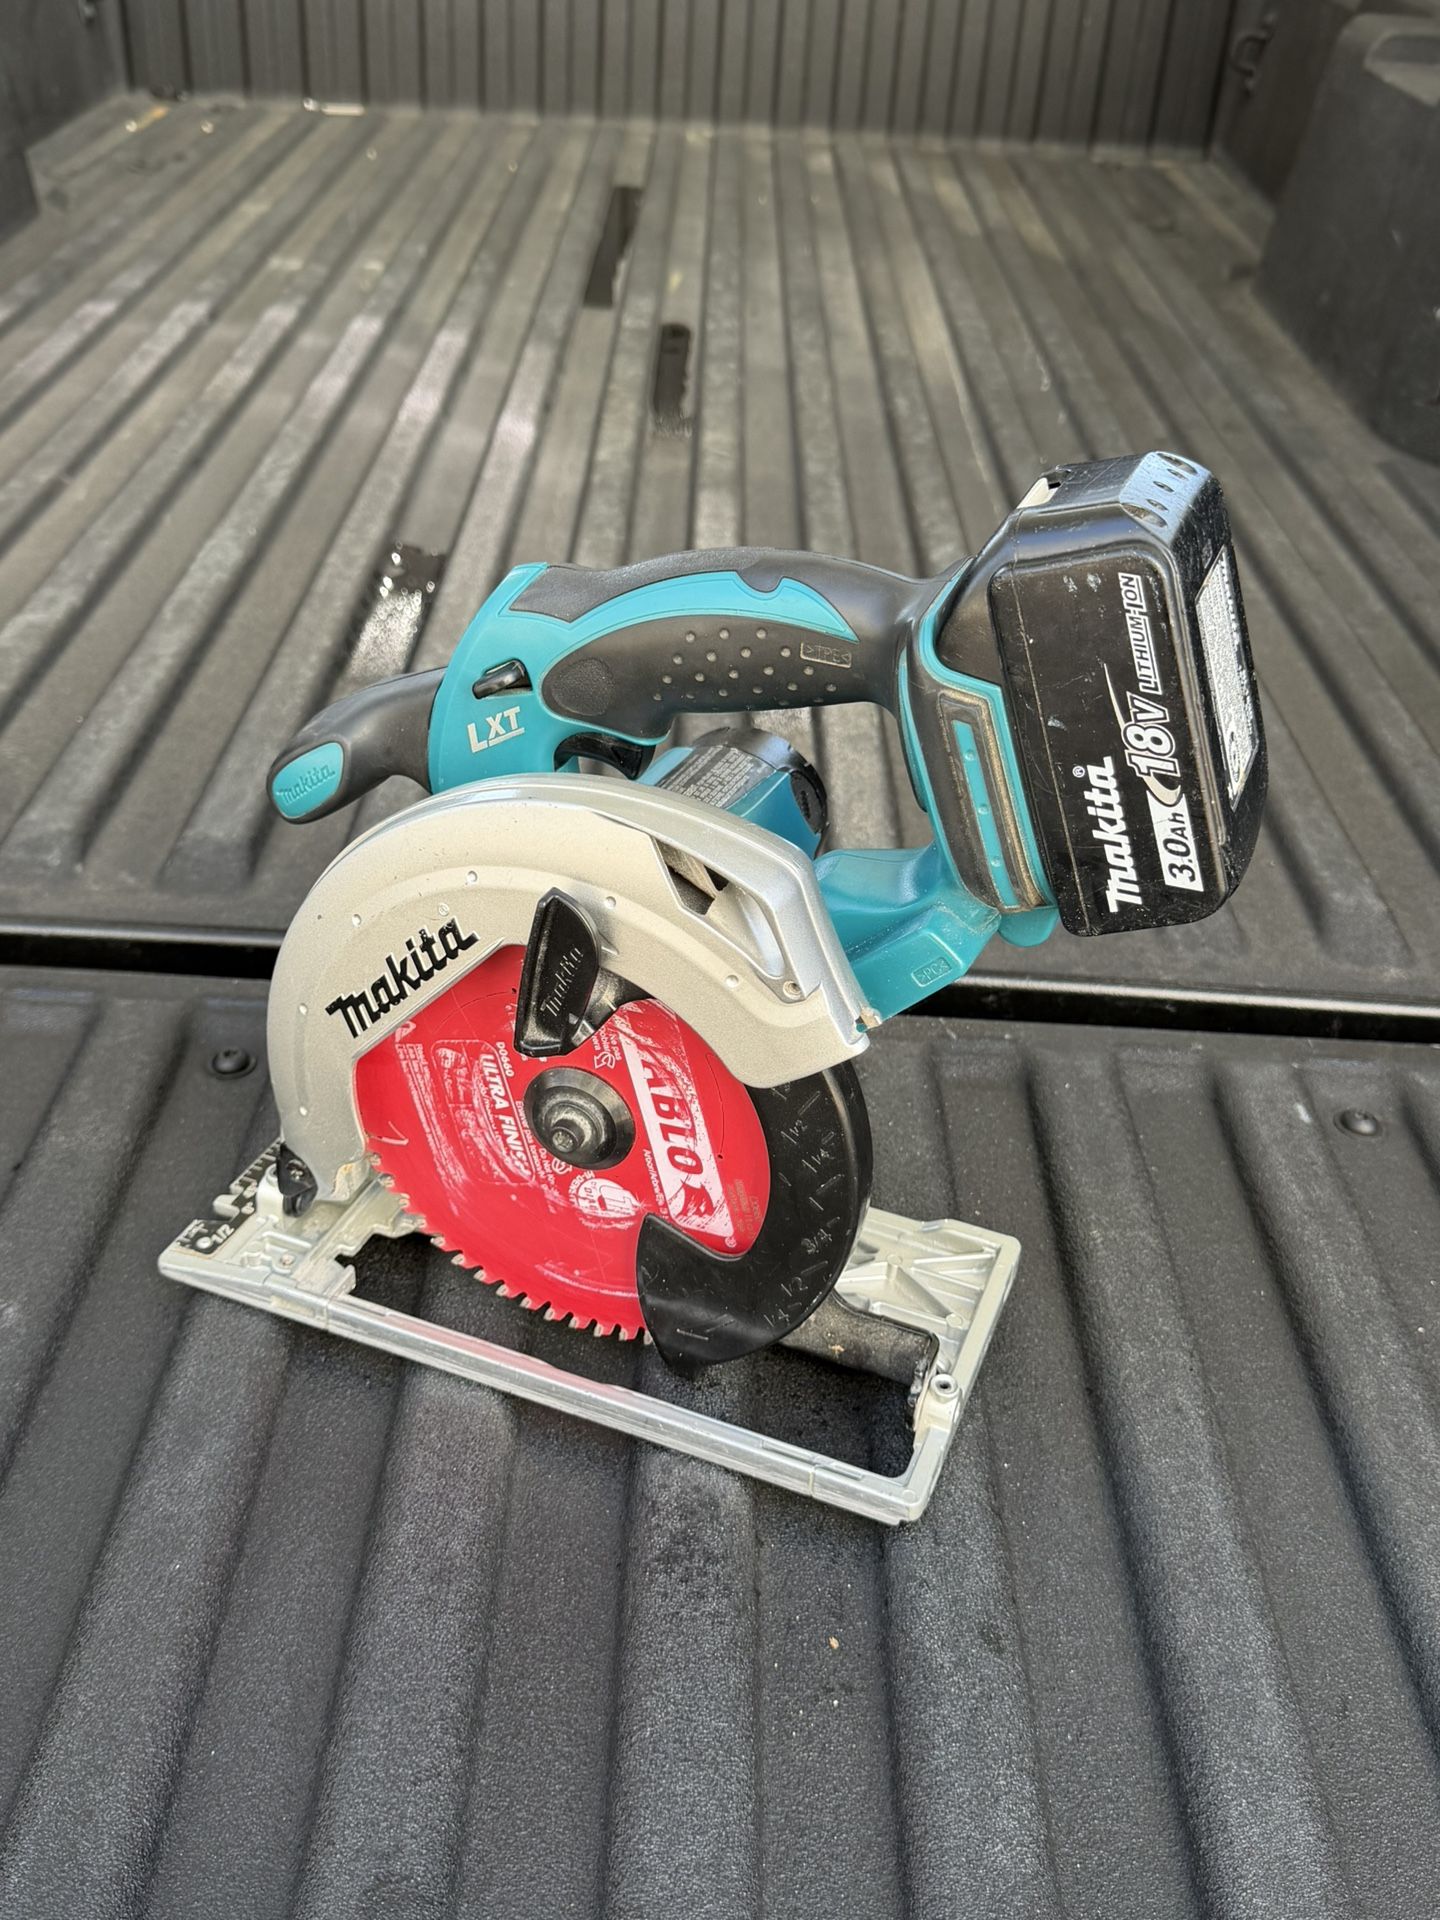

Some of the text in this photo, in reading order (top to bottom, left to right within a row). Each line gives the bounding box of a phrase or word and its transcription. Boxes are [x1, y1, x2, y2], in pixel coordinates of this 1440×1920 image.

[1118, 572, 1161, 696] LITHIUM-ION
[467, 706, 525, 753] LXT
[1124, 692, 1183, 778] 18V
[1163, 811, 1196, 884] 3.0Ah
[480, 1053, 509, 1110] ULTRA
